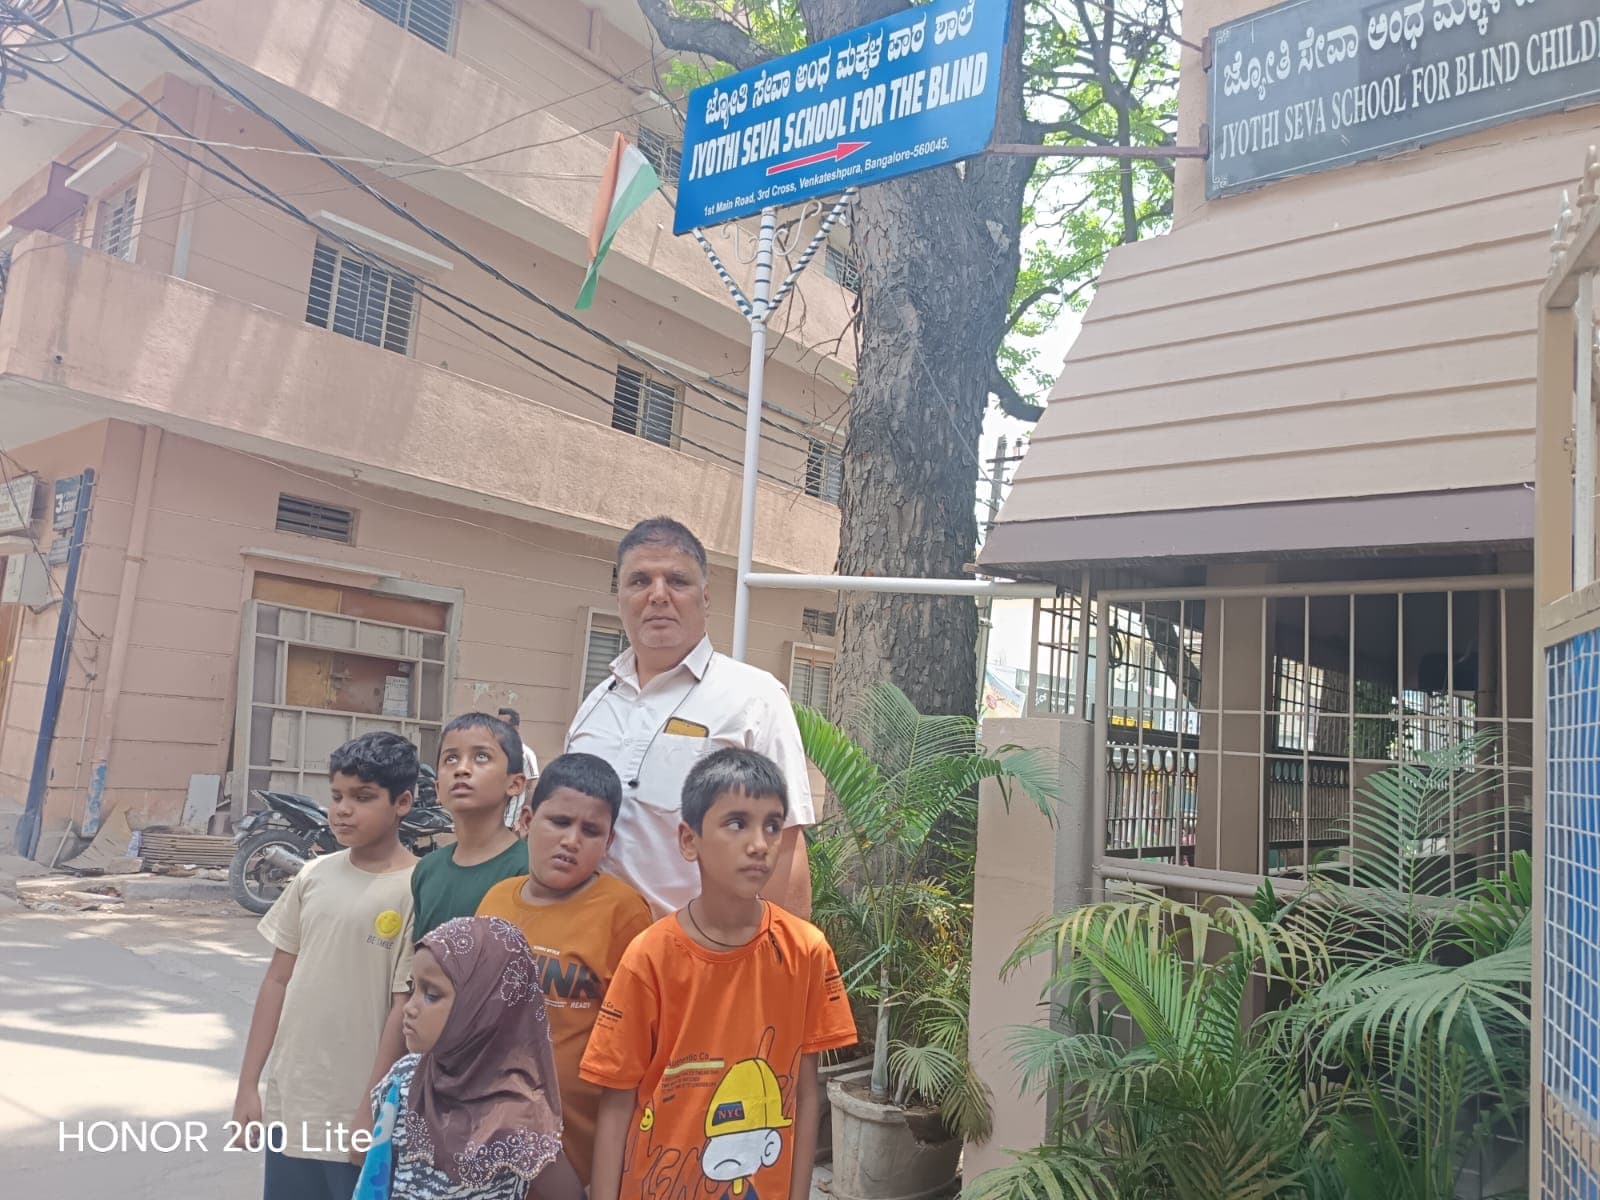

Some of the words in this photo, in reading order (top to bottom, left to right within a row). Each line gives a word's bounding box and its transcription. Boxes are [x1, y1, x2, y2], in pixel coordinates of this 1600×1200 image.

[705, 87, 748, 130] ಜ್ಯೋತಿ
[752, 69, 791, 109] ಸೇವಾ
[795, 46, 832, 92] ಅಂಧ
[836, 27, 884, 80] ಮಕ್ಕಳ
[888, 12, 927, 62] ಪಾಠ
[934, 0, 976, 45] ಶಾಲೆ
[1220, 109, 1279, 160] JYOTHI
[1285, 97, 1327, 144] SEVA
[1331, 74, 1407, 130] SCHOOL
[1411, 61, 1451, 108] FOR
[1455, 41, 1520, 97] BLIND
[1526, 16, 1600, 76] CHILD
[1223, 40, 1291, 100] ಜ್ಯೋತಿ
[1298, 25, 1359, 75] ಸೇವಾ
[1367, 0, 1425, 50] ಅಂಧ
[689, 130, 741, 181] JYOTHI
[741, 115, 780, 166] SEVA
[783, 96, 847, 152] SCHOOL
[850, 83, 887, 133] FOR
[889, 69, 926, 120] THE
[926, 51, 989, 110] BLIND
[703, 203, 715, 217] 1st
[715, 199, 734, 214] Main
[735, 194, 756, 211] Road,
[756, 188, 770, 202] 3rd
[771, 182, 797, 199] Cross,
[799, 162, 863, 189] Venkateshpura,
[864, 136, 950, 171] Bangalore-560045.
[718, 1107, 742, 1120] NYC
